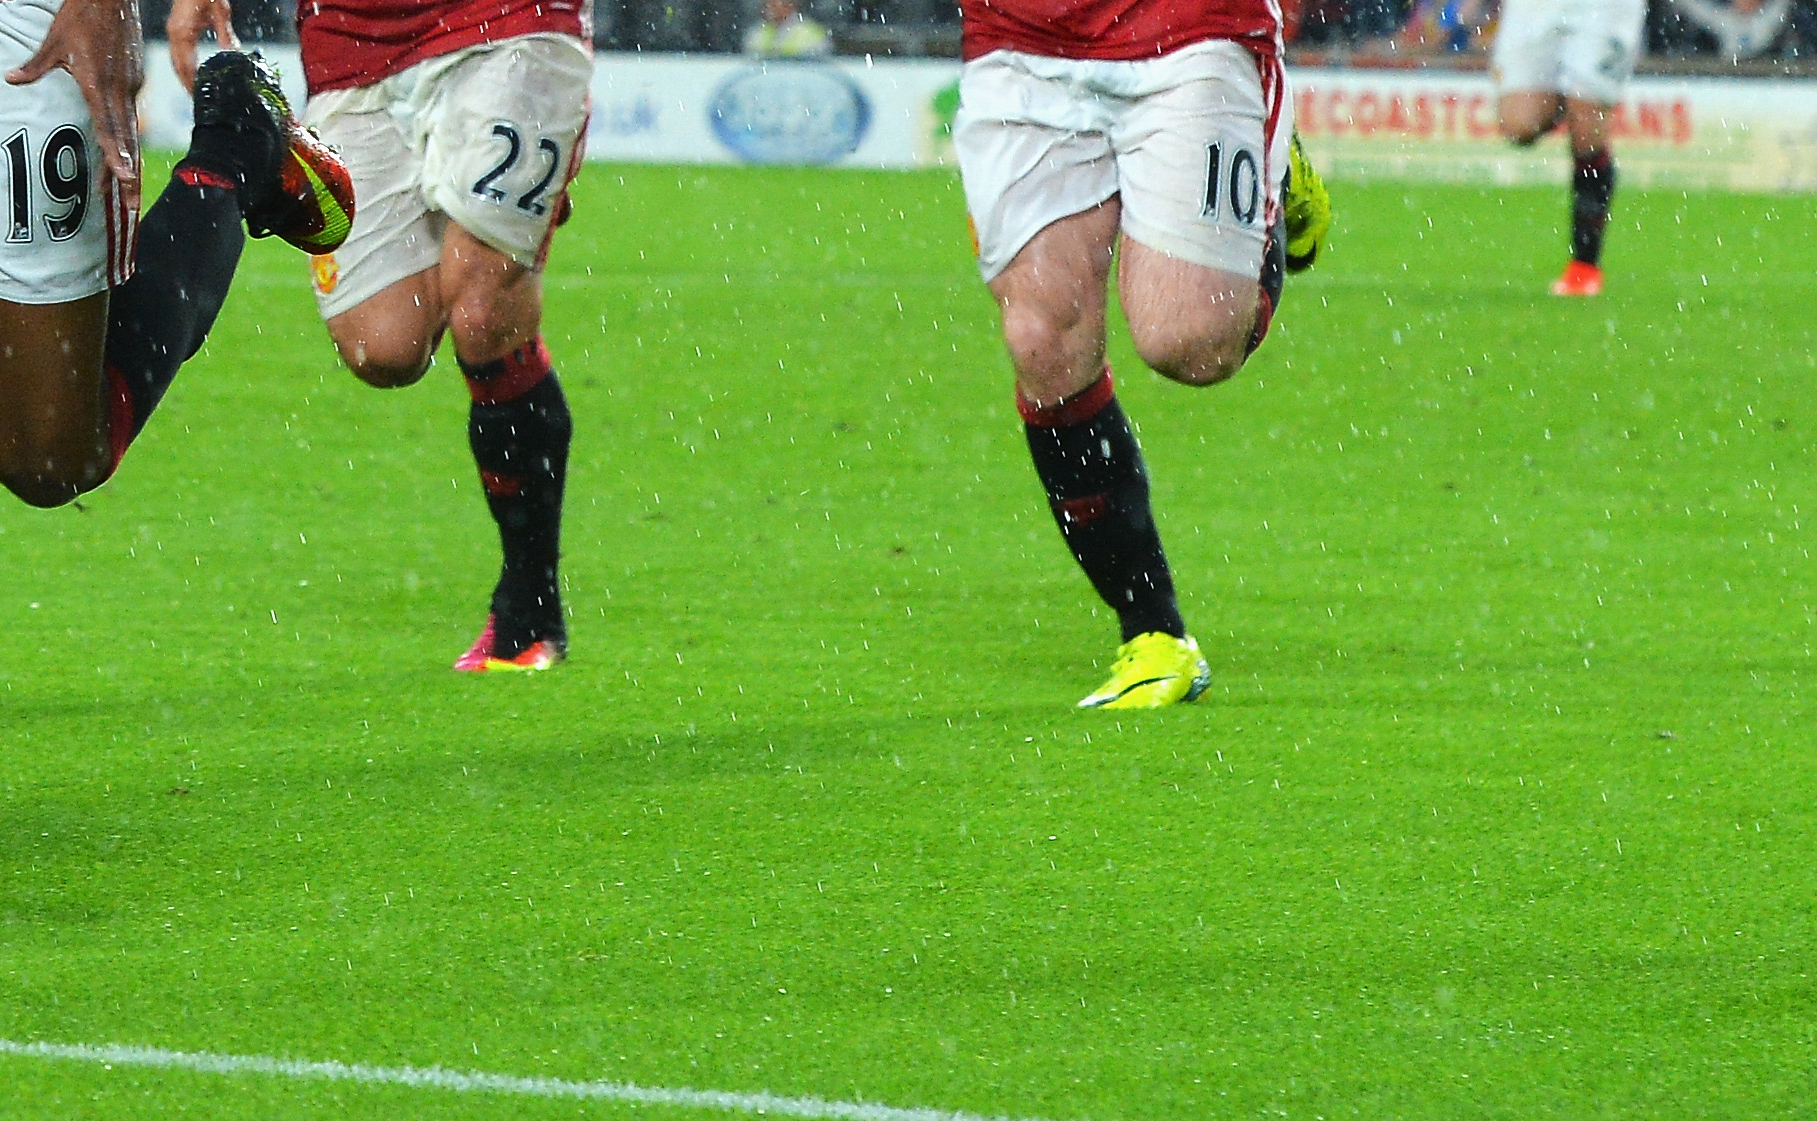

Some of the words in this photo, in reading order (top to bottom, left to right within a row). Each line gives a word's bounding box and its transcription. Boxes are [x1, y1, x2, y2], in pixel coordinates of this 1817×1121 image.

[1, 124, 92, 244] 19
[470, 119, 560, 218] 22
[1199, 139, 1260, 227] 10
